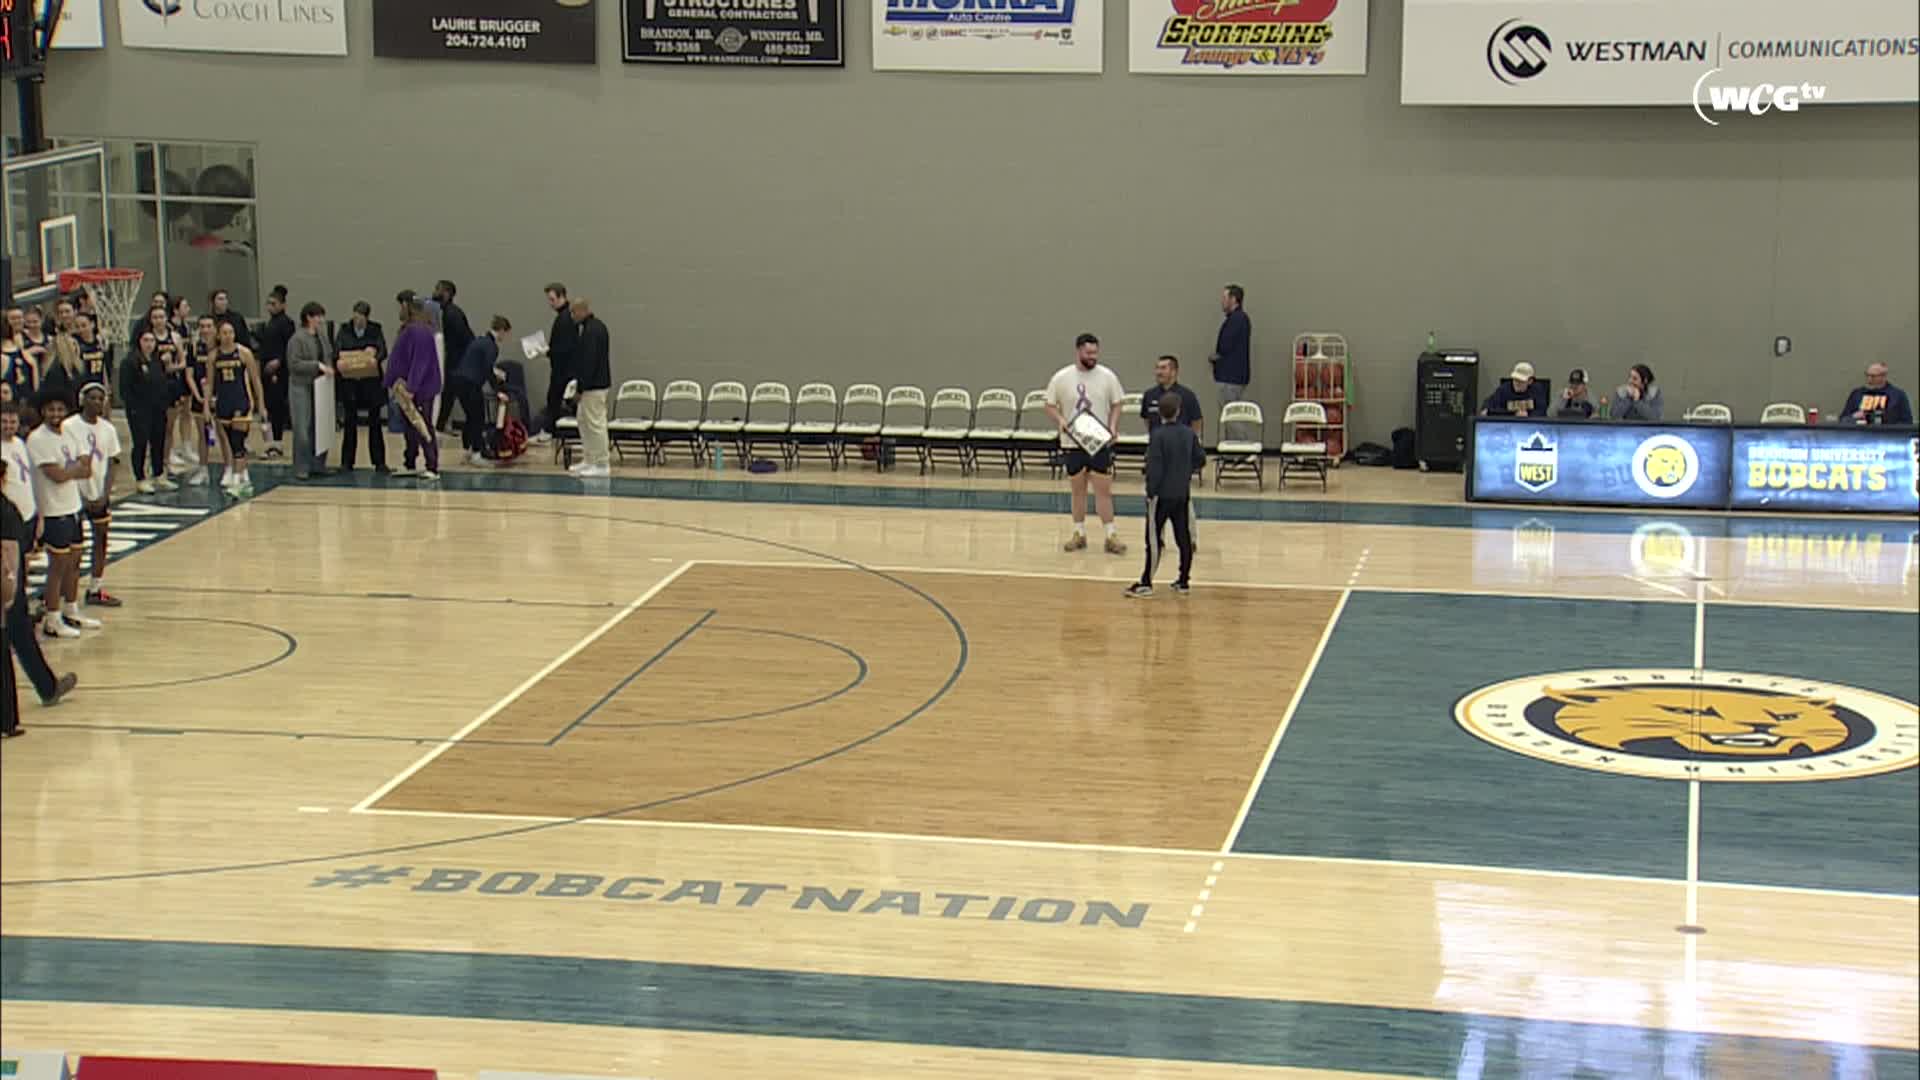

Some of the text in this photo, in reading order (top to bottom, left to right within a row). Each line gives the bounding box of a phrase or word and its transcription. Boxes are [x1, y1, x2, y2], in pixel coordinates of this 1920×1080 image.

[432, 18, 541, 33] LAURIE BRUGGER
[668, 9, 718, 18] GENERAL
[1163, 18, 1326, 46] SPORTSLINE
[1566, 37, 1919, 62] WESTMAN COMMUNICATIONS
[1519, 463, 1554, 481] WEST
[1747, 463, 1888, 491] BOBCATS
[308, 864, 1150, 929] #BOBCATNATION
